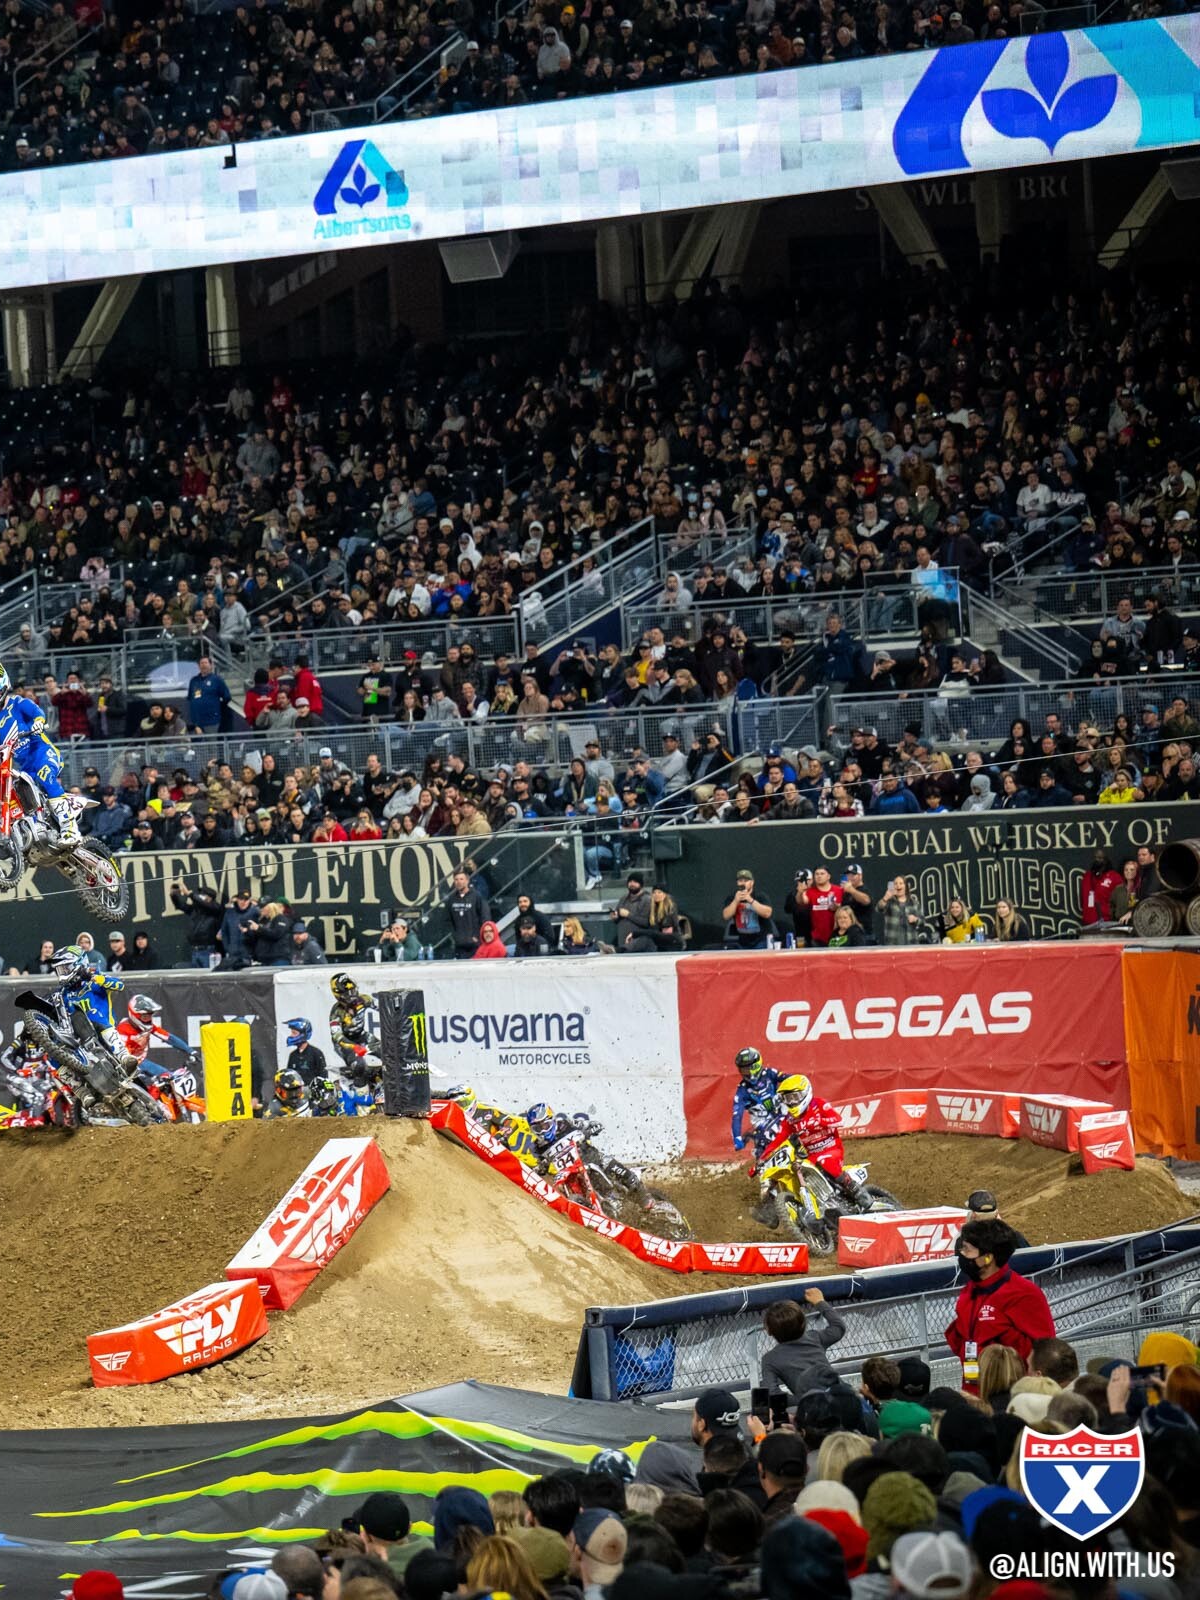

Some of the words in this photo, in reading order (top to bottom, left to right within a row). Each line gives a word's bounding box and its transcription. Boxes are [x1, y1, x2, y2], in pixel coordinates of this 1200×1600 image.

[314, 214, 411, 239] Albertsons
[820, 828, 962, 860] OFFICIAL
[968, 820, 1118, 853] WHISKEY
[1127, 817, 1173, 846] OF
[120, 841, 470, 923] TEMPLETON
[766, 991, 1032, 1042] GASGAS
[499, 1053, 591, 1065] MOTORCYCLES
[179, 1078, 194, 1096] 12
[836, 1098, 882, 1129] LY
[936, 1095, 993, 1123] FLY
[1024, 1102, 1063, 1135] FLY
[463, 1113, 507, 1156] FLY
[946, 1122, 981, 1131] RACING
[467, 1134, 495, 1159] RACING
[519, 1161, 561, 1202] FLY
[288, 1162, 364, 1263] FLY
[579, 1208, 626, 1238] FLY
[316, 1209, 364, 1268] RACING
[638, 1232, 684, 1258] FLY
[897, 1222, 963, 1255] FLY
[701, 1246, 746, 1263] FLY
[757, 1247, 799, 1263] FLY
[153, 1294, 244, 1355] FLY
[182, 1336, 234, 1366] RACING
